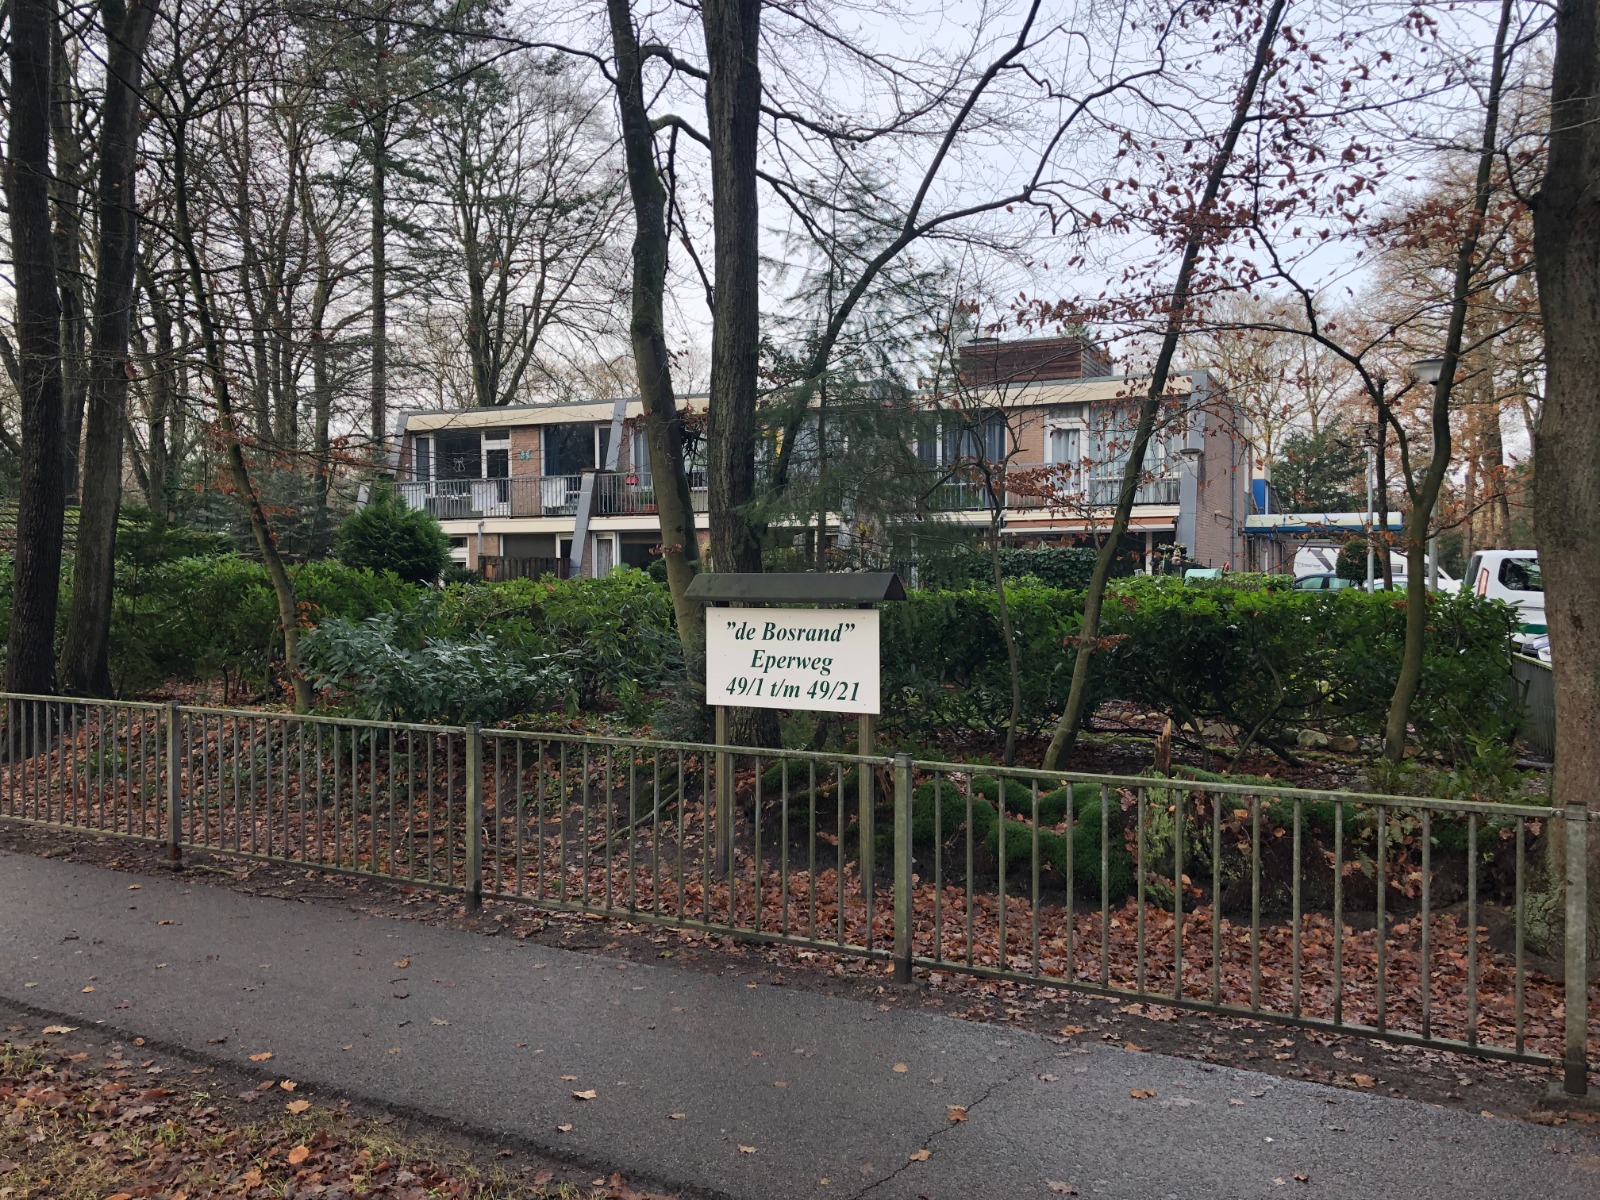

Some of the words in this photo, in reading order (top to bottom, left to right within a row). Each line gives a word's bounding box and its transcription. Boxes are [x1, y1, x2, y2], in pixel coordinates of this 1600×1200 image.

[750, 649, 834, 676] Eperweg
[725, 676, 764, 696] 49/1
[770, 678, 801, 698] t/m
[806, 680, 860, 702] 49/21
